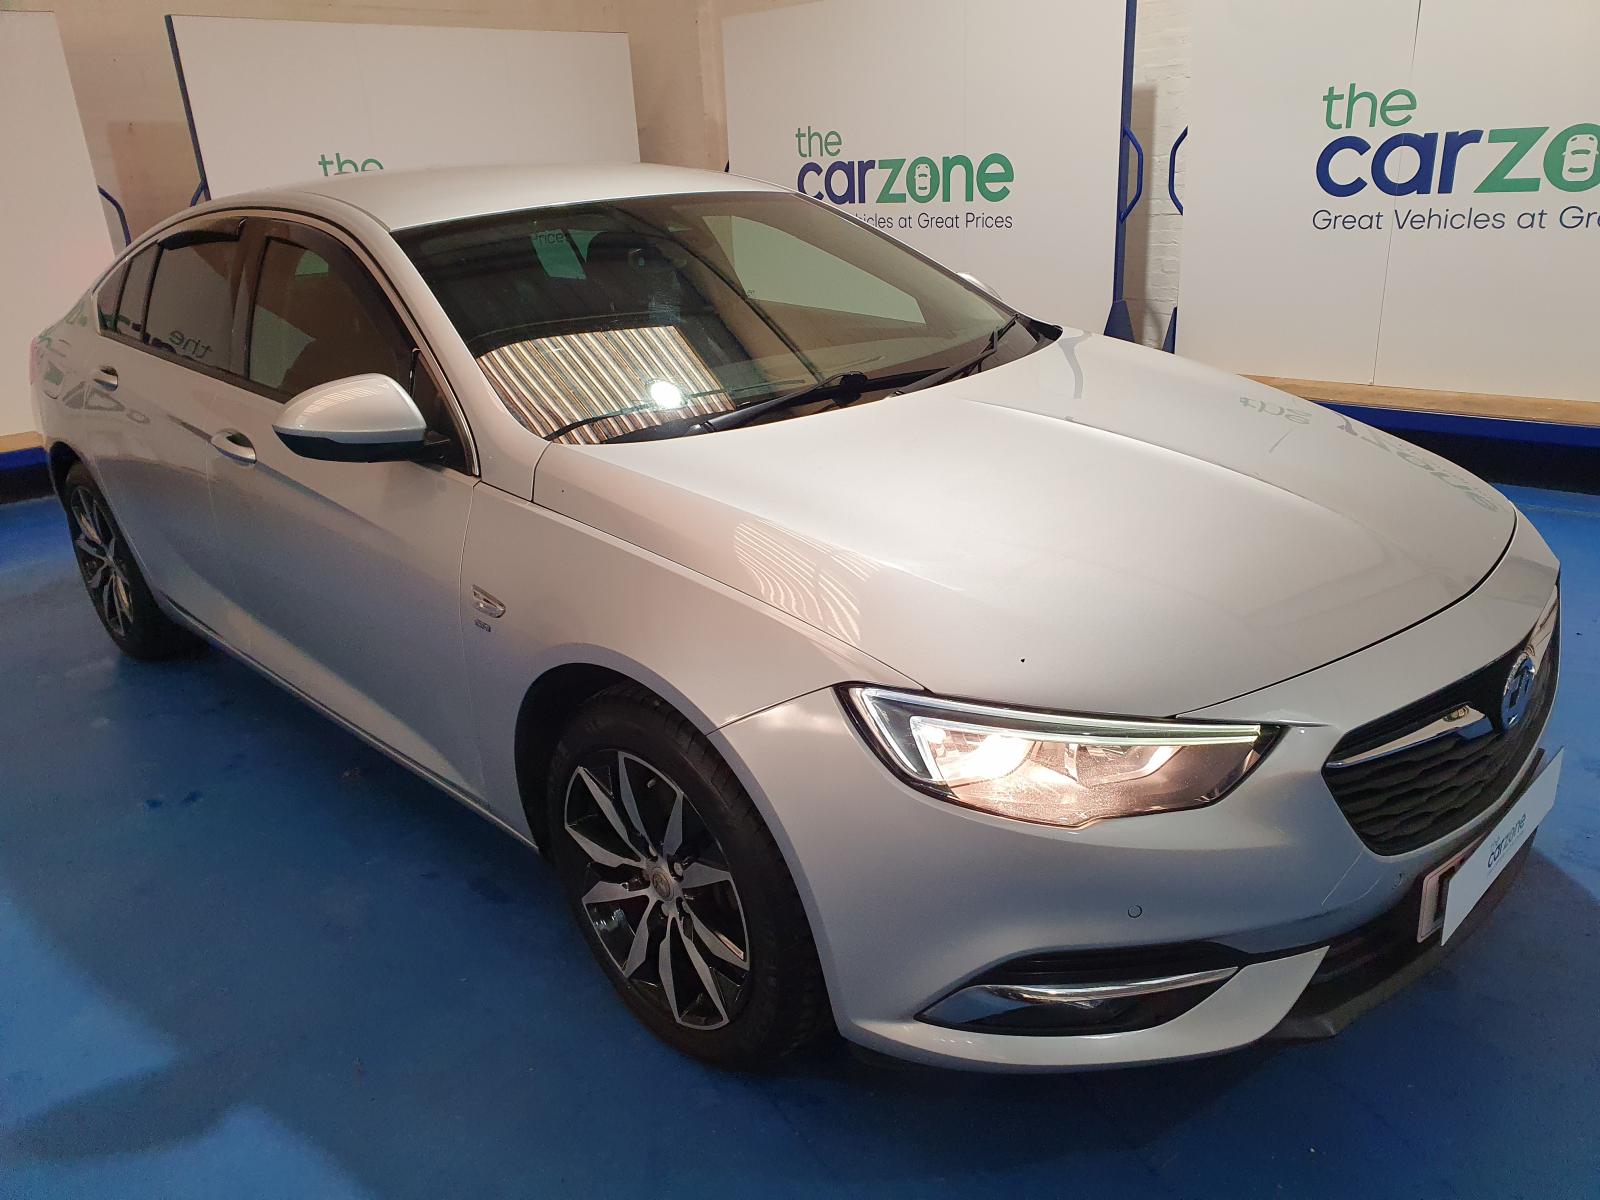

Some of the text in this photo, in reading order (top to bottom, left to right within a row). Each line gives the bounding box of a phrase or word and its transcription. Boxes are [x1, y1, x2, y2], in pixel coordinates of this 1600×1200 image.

[1322, 83, 1418, 129] the
[795, 125, 843, 158] the
[797, 152, 1015, 205] carzone
[898, 214, 913, 229] at
[917, 212, 960, 229] Great
[965, 211, 1013, 229] Prices
[1312, 205, 1600, 230] Great Vehicles at Gr
